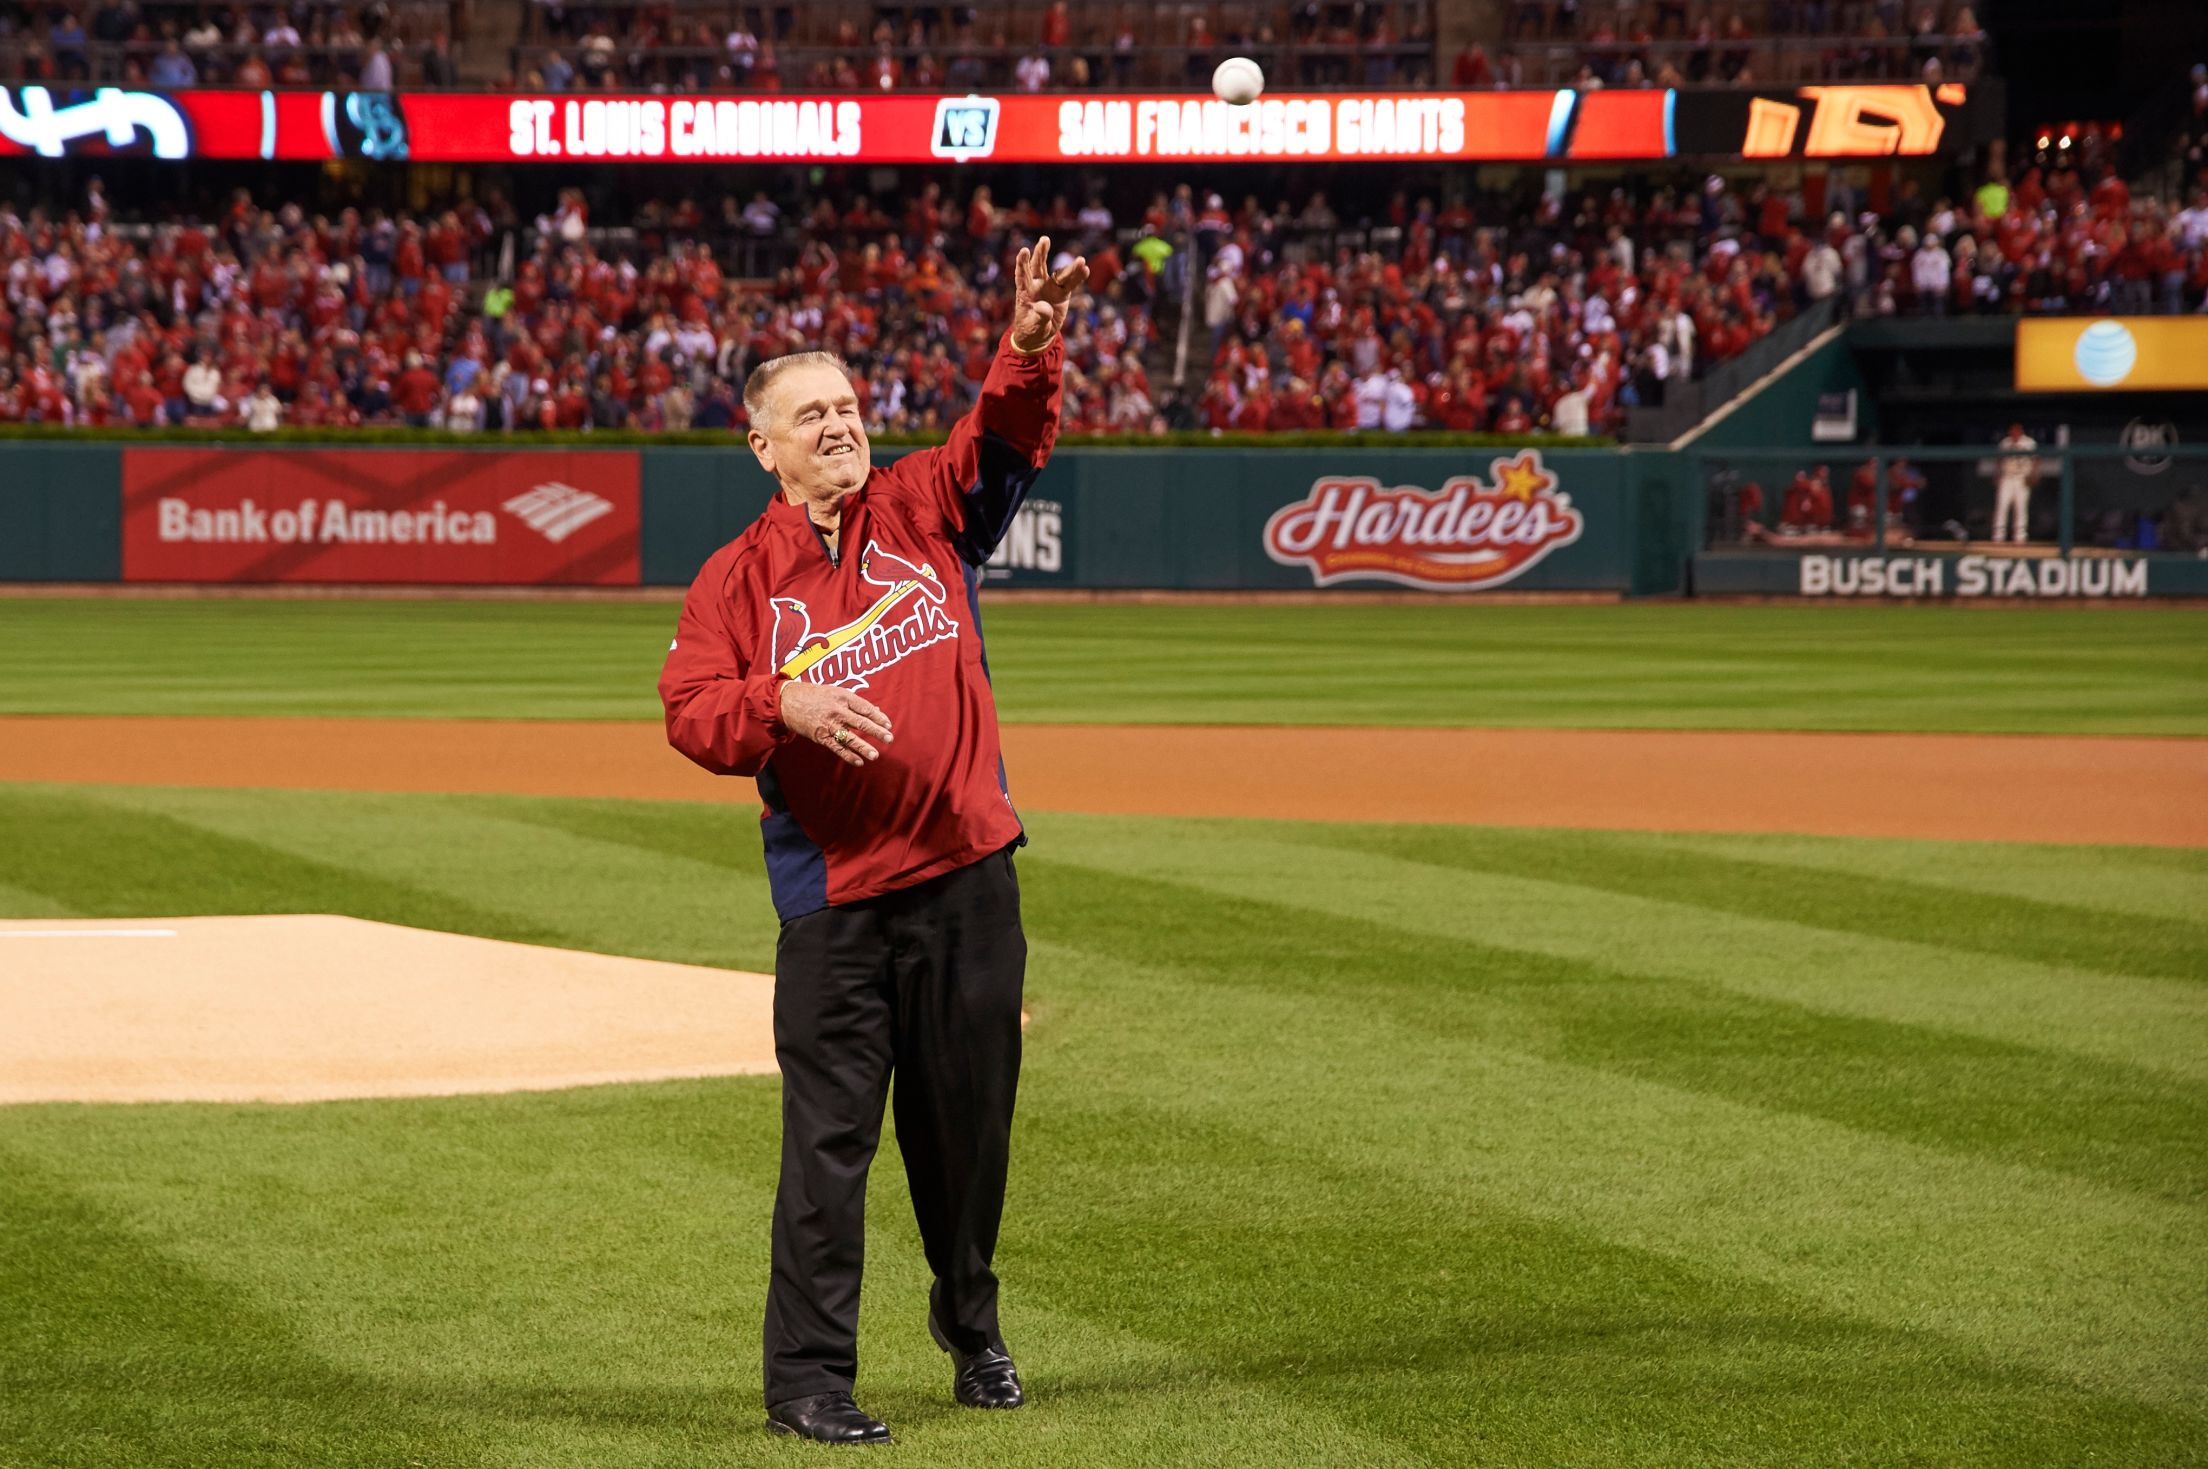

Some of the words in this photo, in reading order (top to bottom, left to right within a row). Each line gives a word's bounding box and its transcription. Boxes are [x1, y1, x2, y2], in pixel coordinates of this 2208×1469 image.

[509, 100, 561, 155] ST.
[565, 100, 665, 155] LOUIS
[670, 100, 861, 155] CARDINALS
[945, 110, 986, 146] VS
[1058, 100, 1131, 155] SAN
[1136, 99, 1331, 155] FRANCISCO
[1336, 98, 1465, 154] GIANTS
[158, 498, 267, 542] Bank
[270, 498, 317, 542] of
[320, 500, 497, 543] America
[1800, 556, 1944, 596] BUSCH
[1955, 555, 2148, 596] STADIUM
